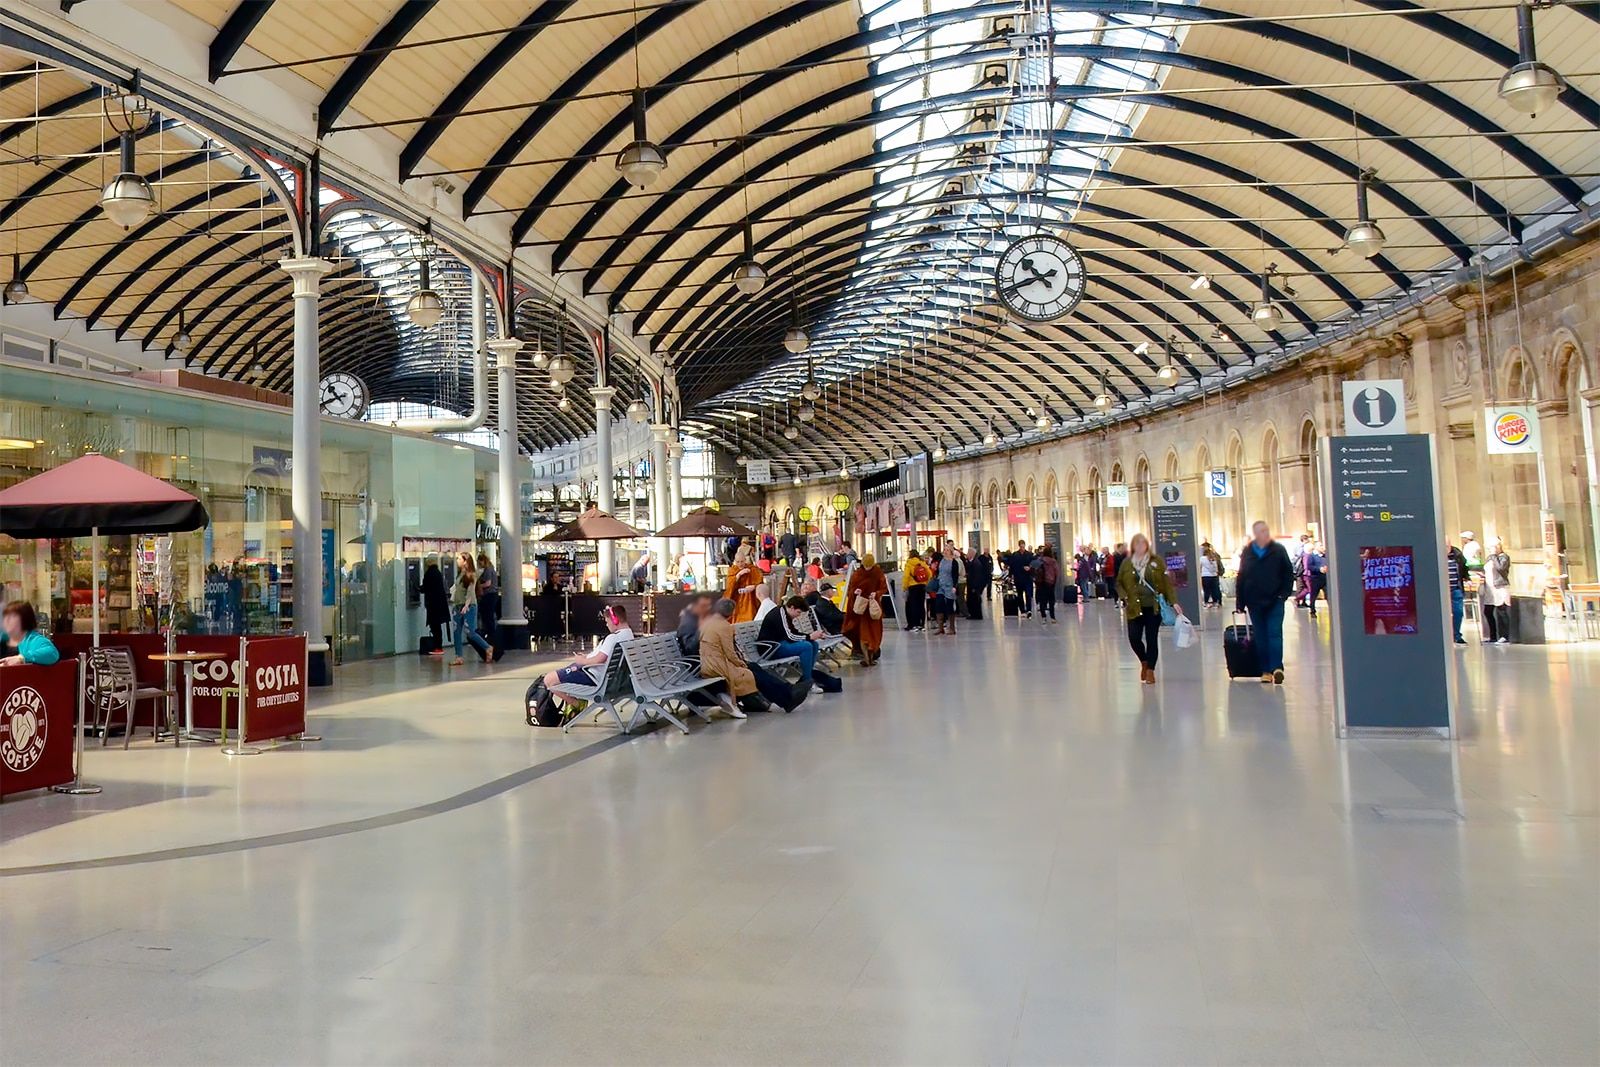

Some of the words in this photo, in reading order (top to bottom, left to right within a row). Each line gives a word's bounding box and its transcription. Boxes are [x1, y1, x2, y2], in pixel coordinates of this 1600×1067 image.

[1498, 418, 1525, 432] BURGER
[1500, 424, 1526, 439] KING
[1364, 558, 1380, 566] HEY
[1382, 555, 1410, 565] THERE
[1365, 565, 1398, 578] NEED
[1401, 563, 1411, 574] A
[204, 580, 228, 594] elcome
[1365, 575, 1412, 590] HAND?
[256, 664, 299, 690] COSTA
[193, 686, 210, 696] FOR
[5, 690, 40, 716] COSTA
[266, 694, 282, 706] COFFEE
[283, 692, 299, 703] LOVERS
[2, 736, 43, 768] COFFEE
